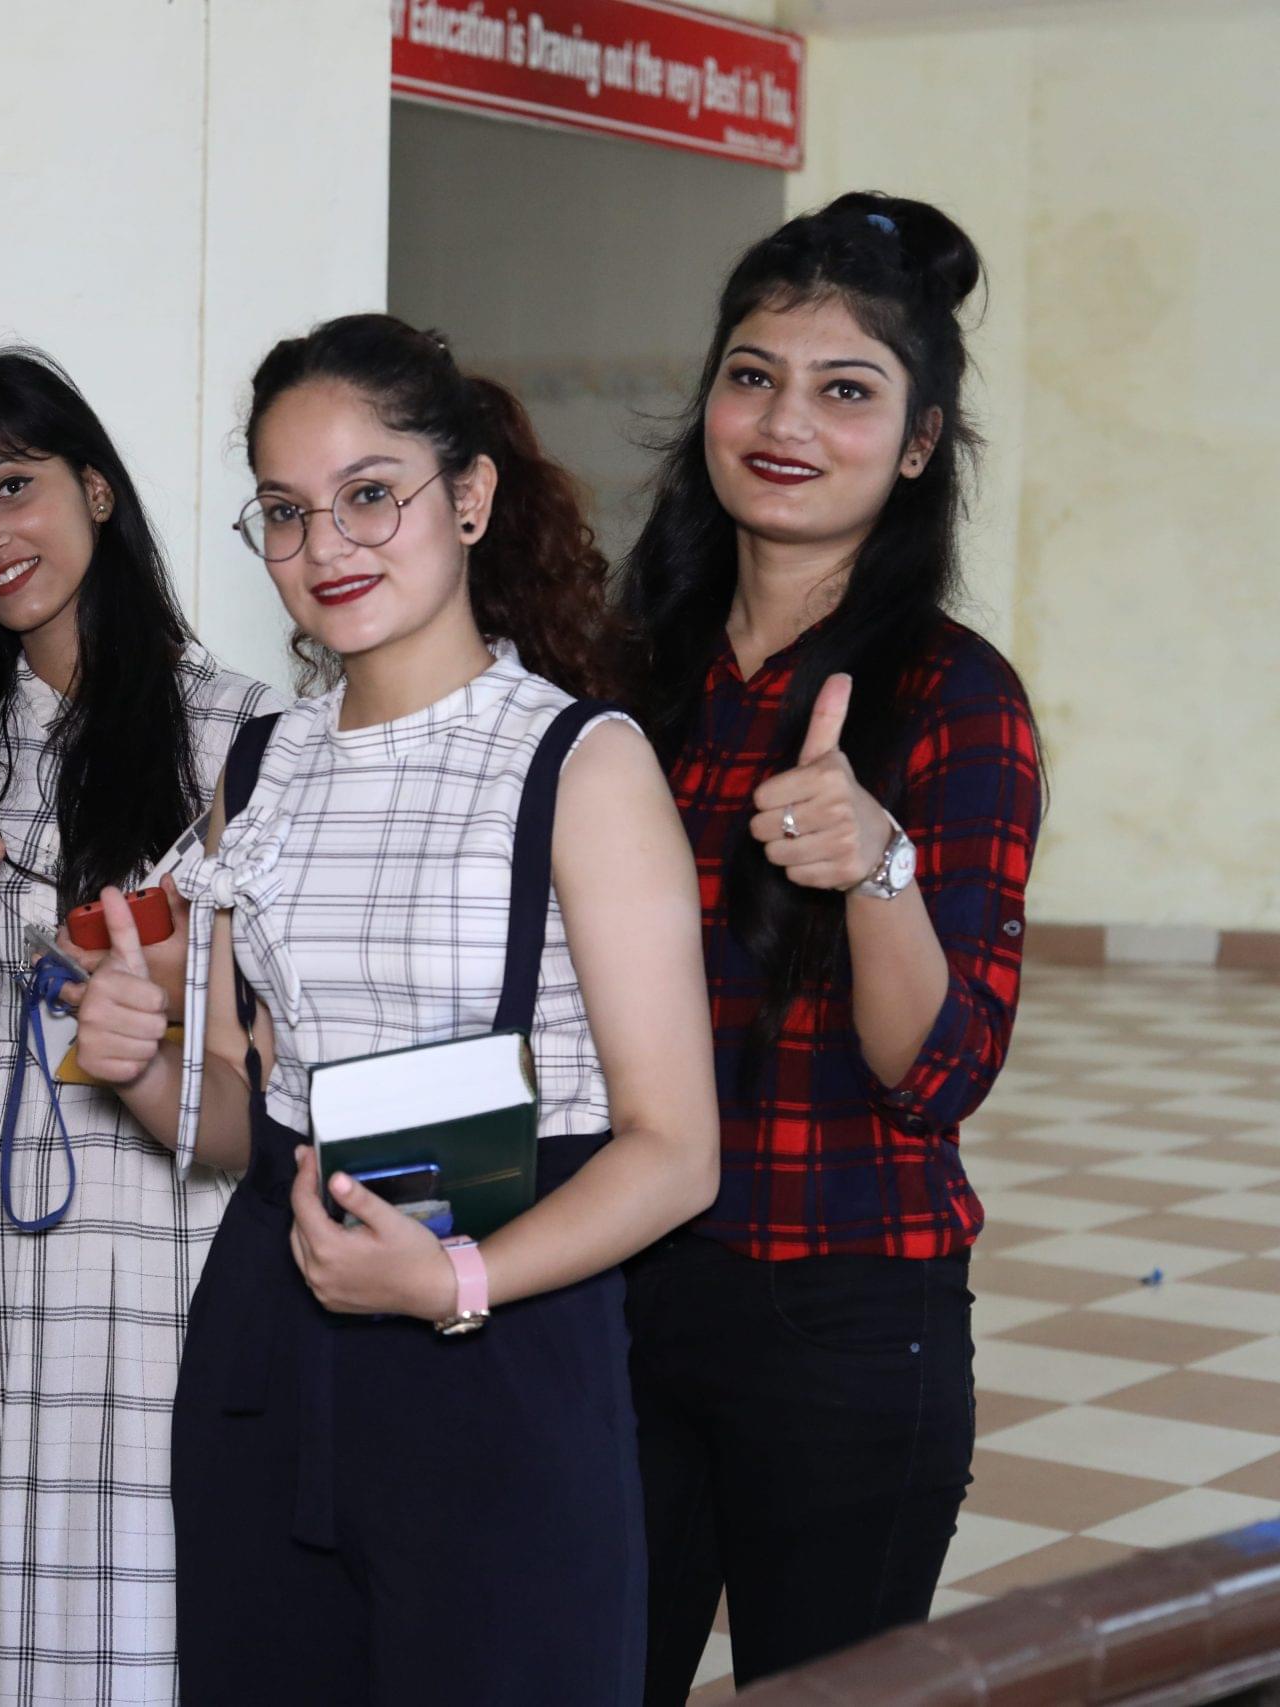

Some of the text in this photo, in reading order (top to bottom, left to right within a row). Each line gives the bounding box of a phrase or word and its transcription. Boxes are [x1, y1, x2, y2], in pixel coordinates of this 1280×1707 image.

[409, 0, 505, 61] Education
[507, 7, 525, 67] is
[527, 12, 600, 97] Drawing
[603, 40, 633, 92] out
[634, 40, 662, 97] the
[664, 58, 701, 120] very
[703, 55, 739, 114] Best
[740, 65, 759, 119] in
